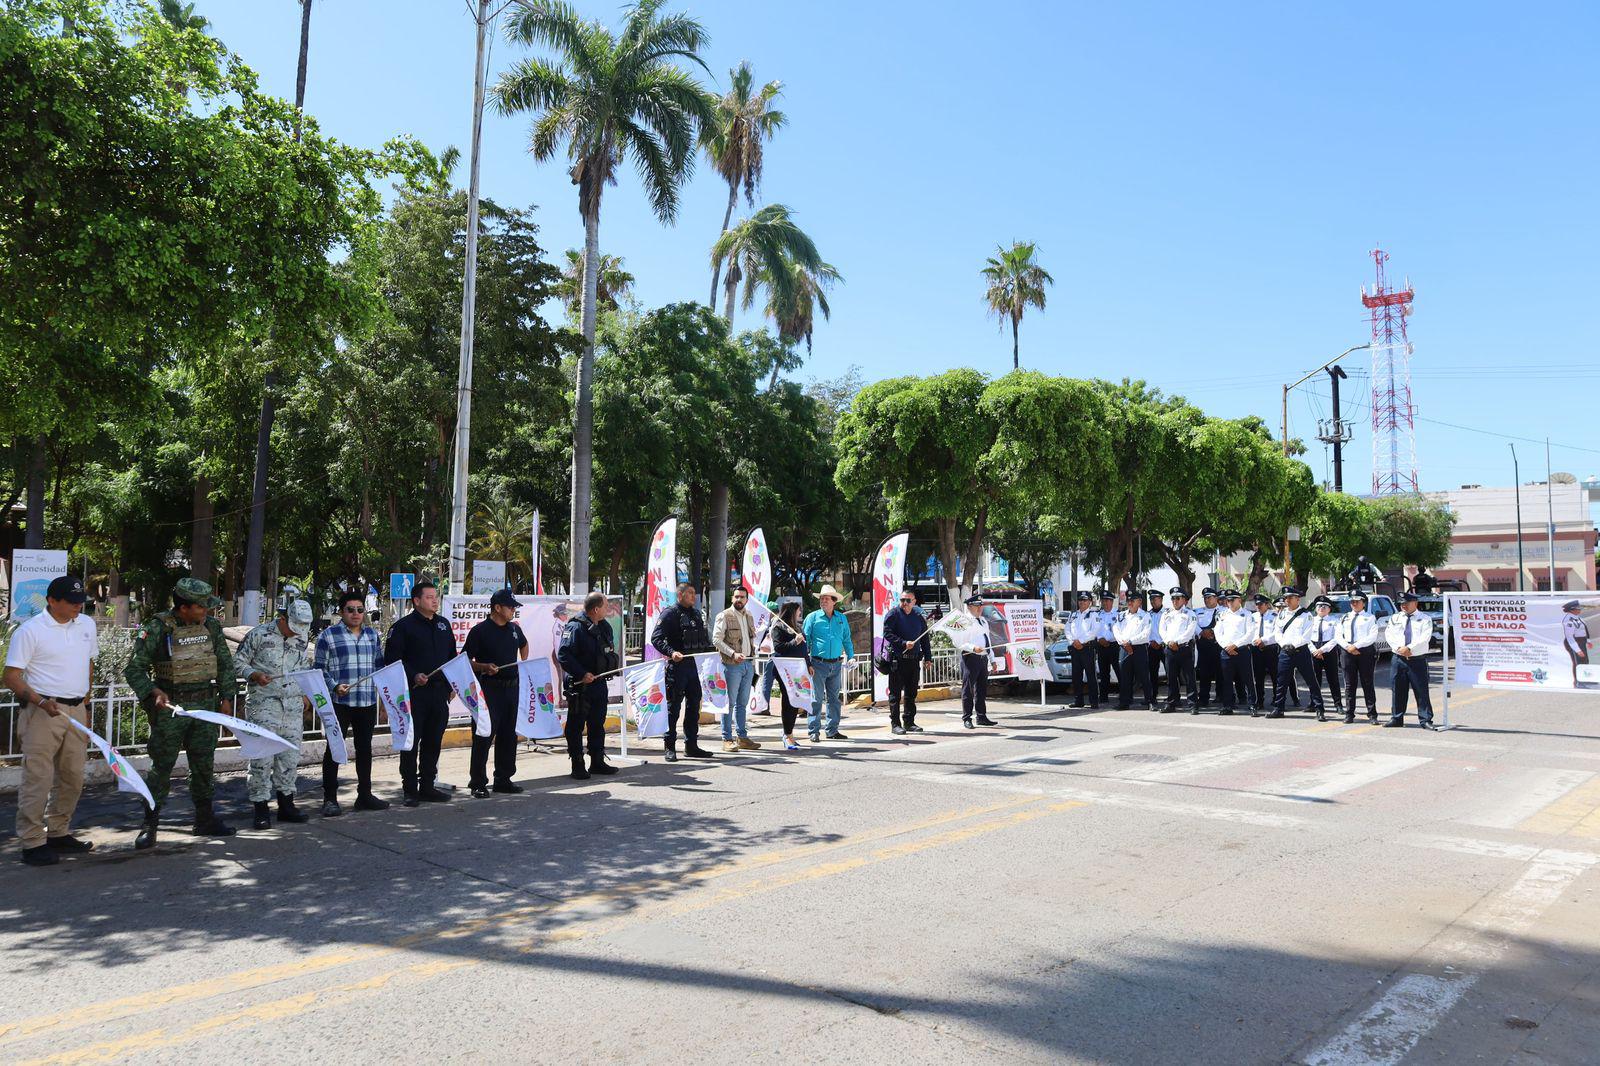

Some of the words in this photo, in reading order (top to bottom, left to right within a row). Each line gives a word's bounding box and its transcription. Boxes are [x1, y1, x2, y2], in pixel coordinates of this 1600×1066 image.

[15, 564, 66, 573] Honestidad
[474, 576, 504, 586] Integridad
[1483, 613, 1527, 621] ESTADO
[451, 622, 472, 630] DEL
[1478, 622, 1527, 630] SINALOA
[454, 634, 465, 642] DE
